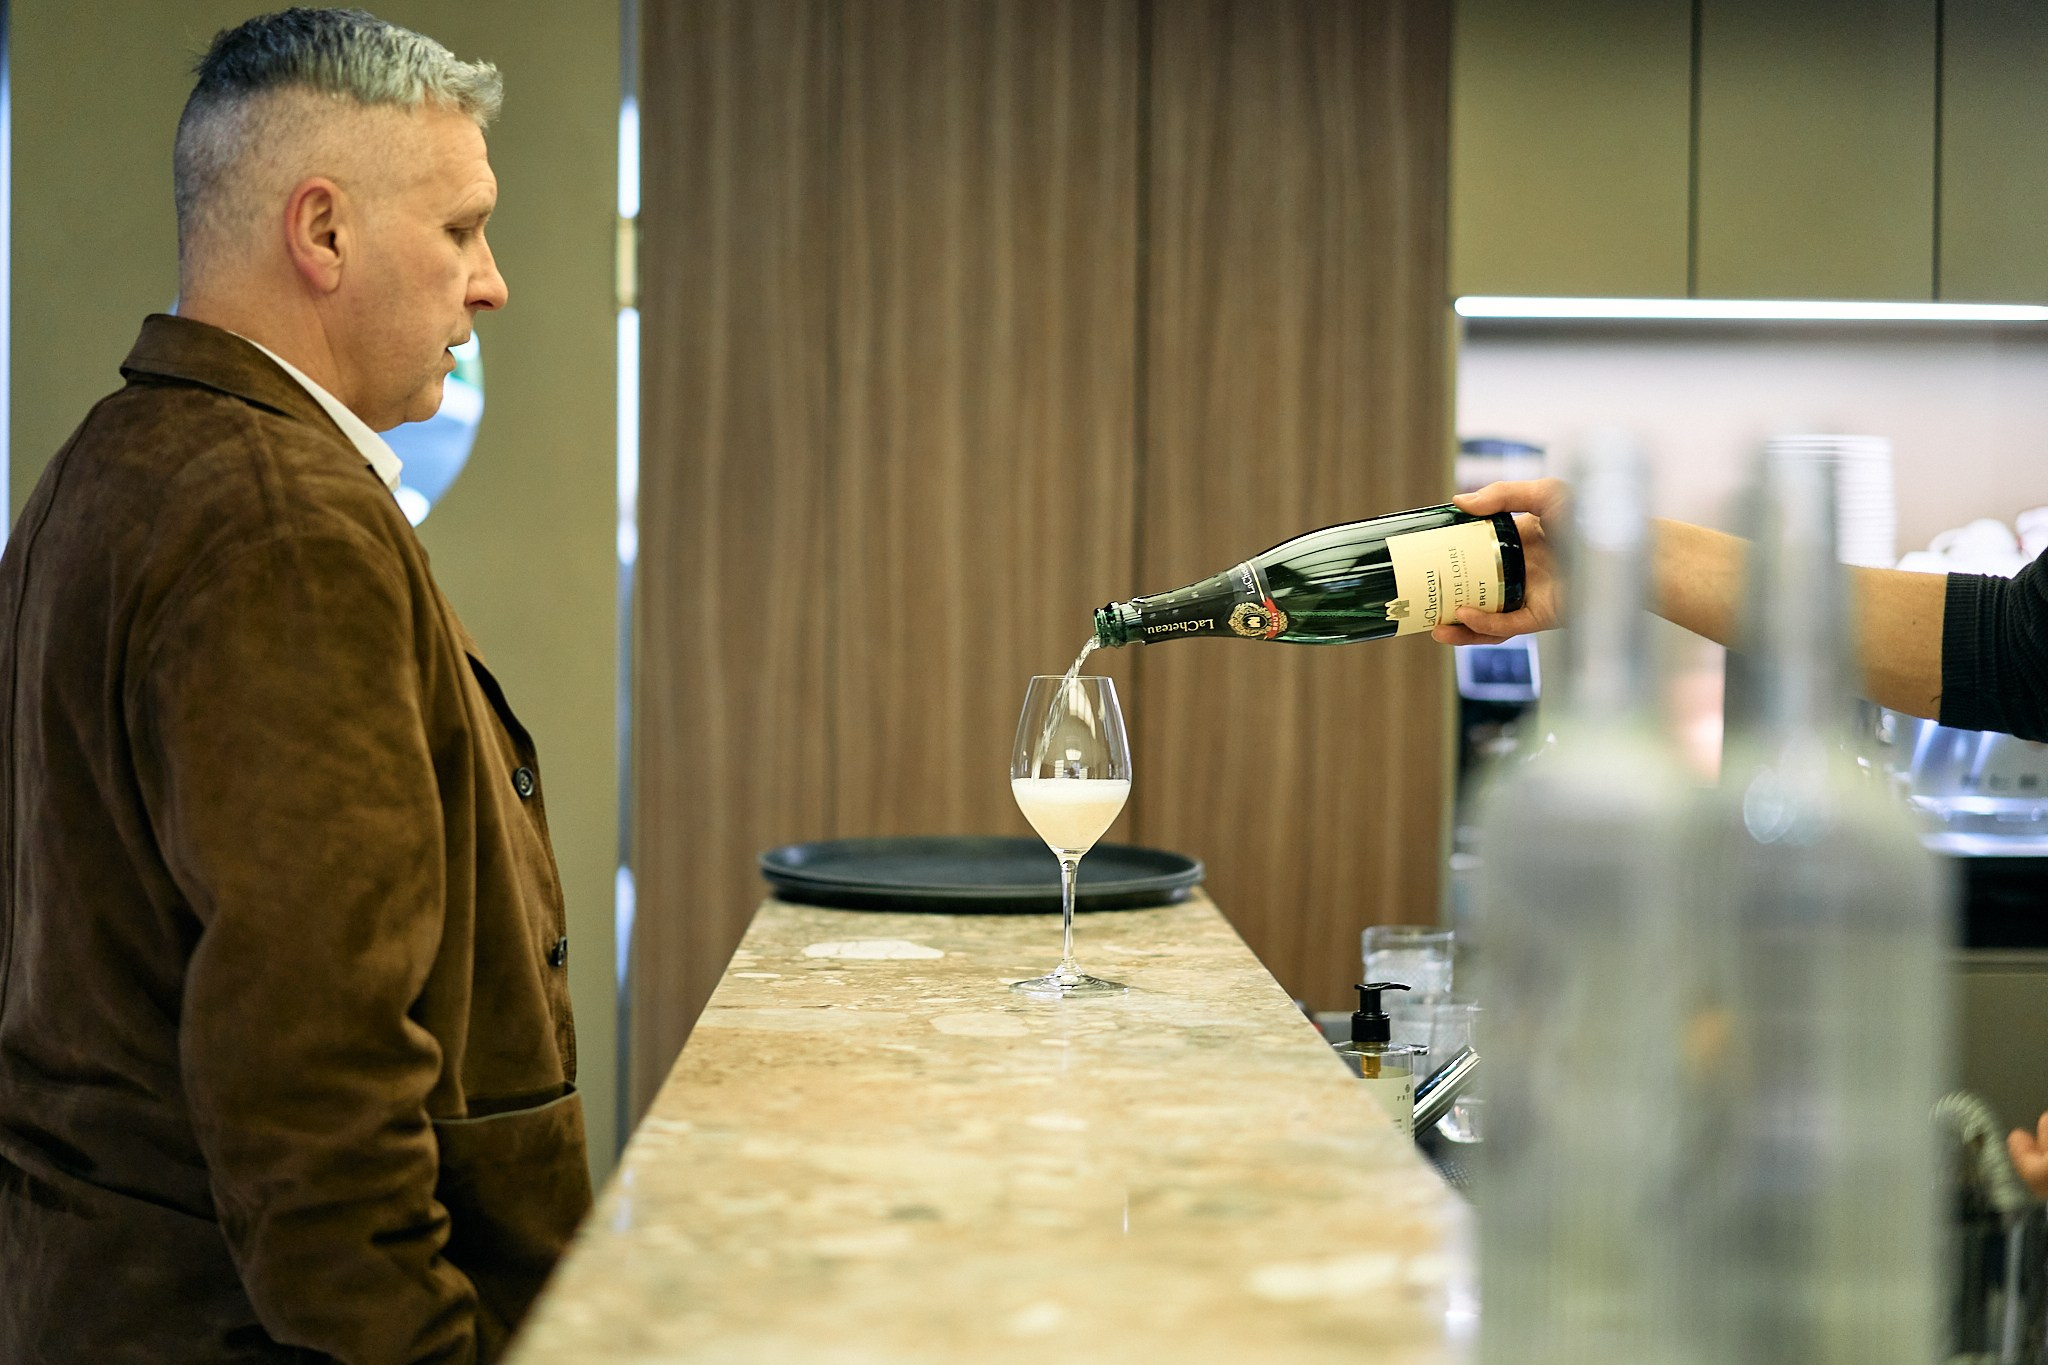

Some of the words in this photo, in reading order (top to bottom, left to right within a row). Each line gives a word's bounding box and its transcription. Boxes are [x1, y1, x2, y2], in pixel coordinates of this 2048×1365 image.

[1448, 546, 1462, 578] LOIRE
[1422, 570, 1439, 629] LaCheteau
[1454, 582, 1464, 596] DE
[1479, 581, 1487, 607] BRUT
[1147, 618, 1214, 635] LaCheteau
[1271, 612, 1279, 631] BRUT
